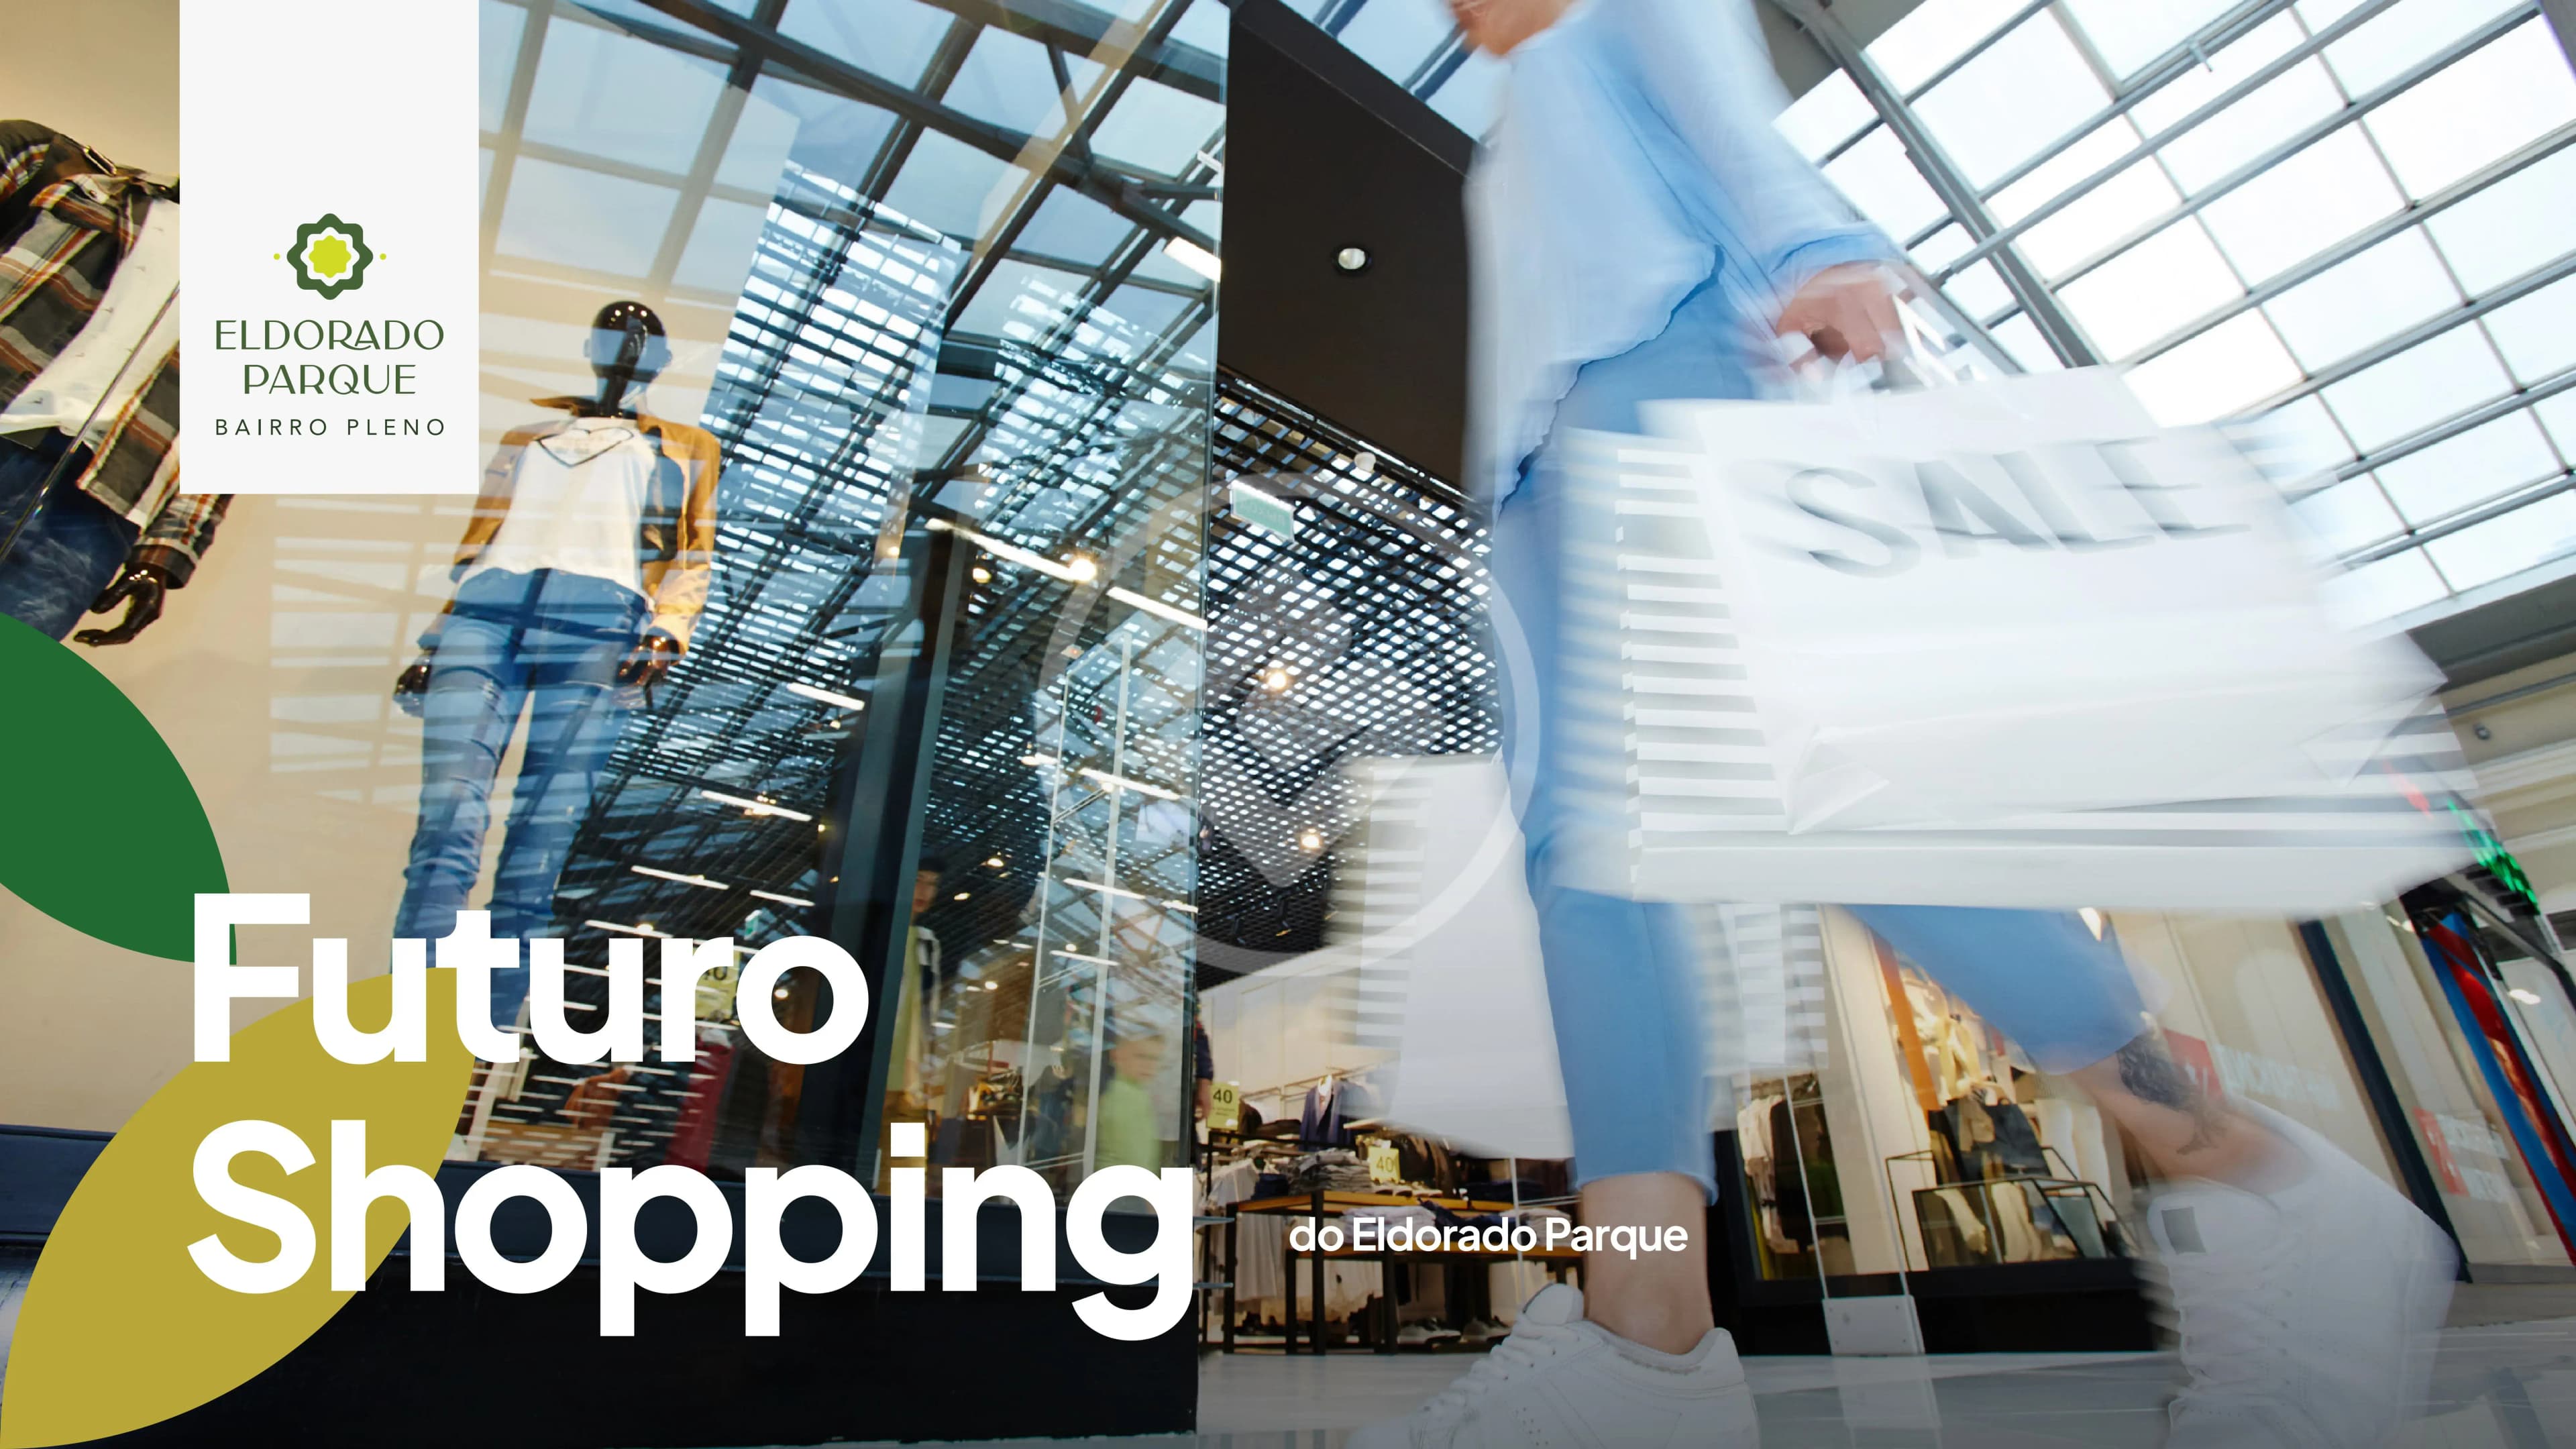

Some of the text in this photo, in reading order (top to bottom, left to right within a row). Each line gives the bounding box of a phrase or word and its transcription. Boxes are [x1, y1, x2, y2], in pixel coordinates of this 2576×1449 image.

[1771, 437, 2253, 578] SALE
[1214, 1089, 1232, 1104] 40
[1376, 1156, 1394, 1173] 40
